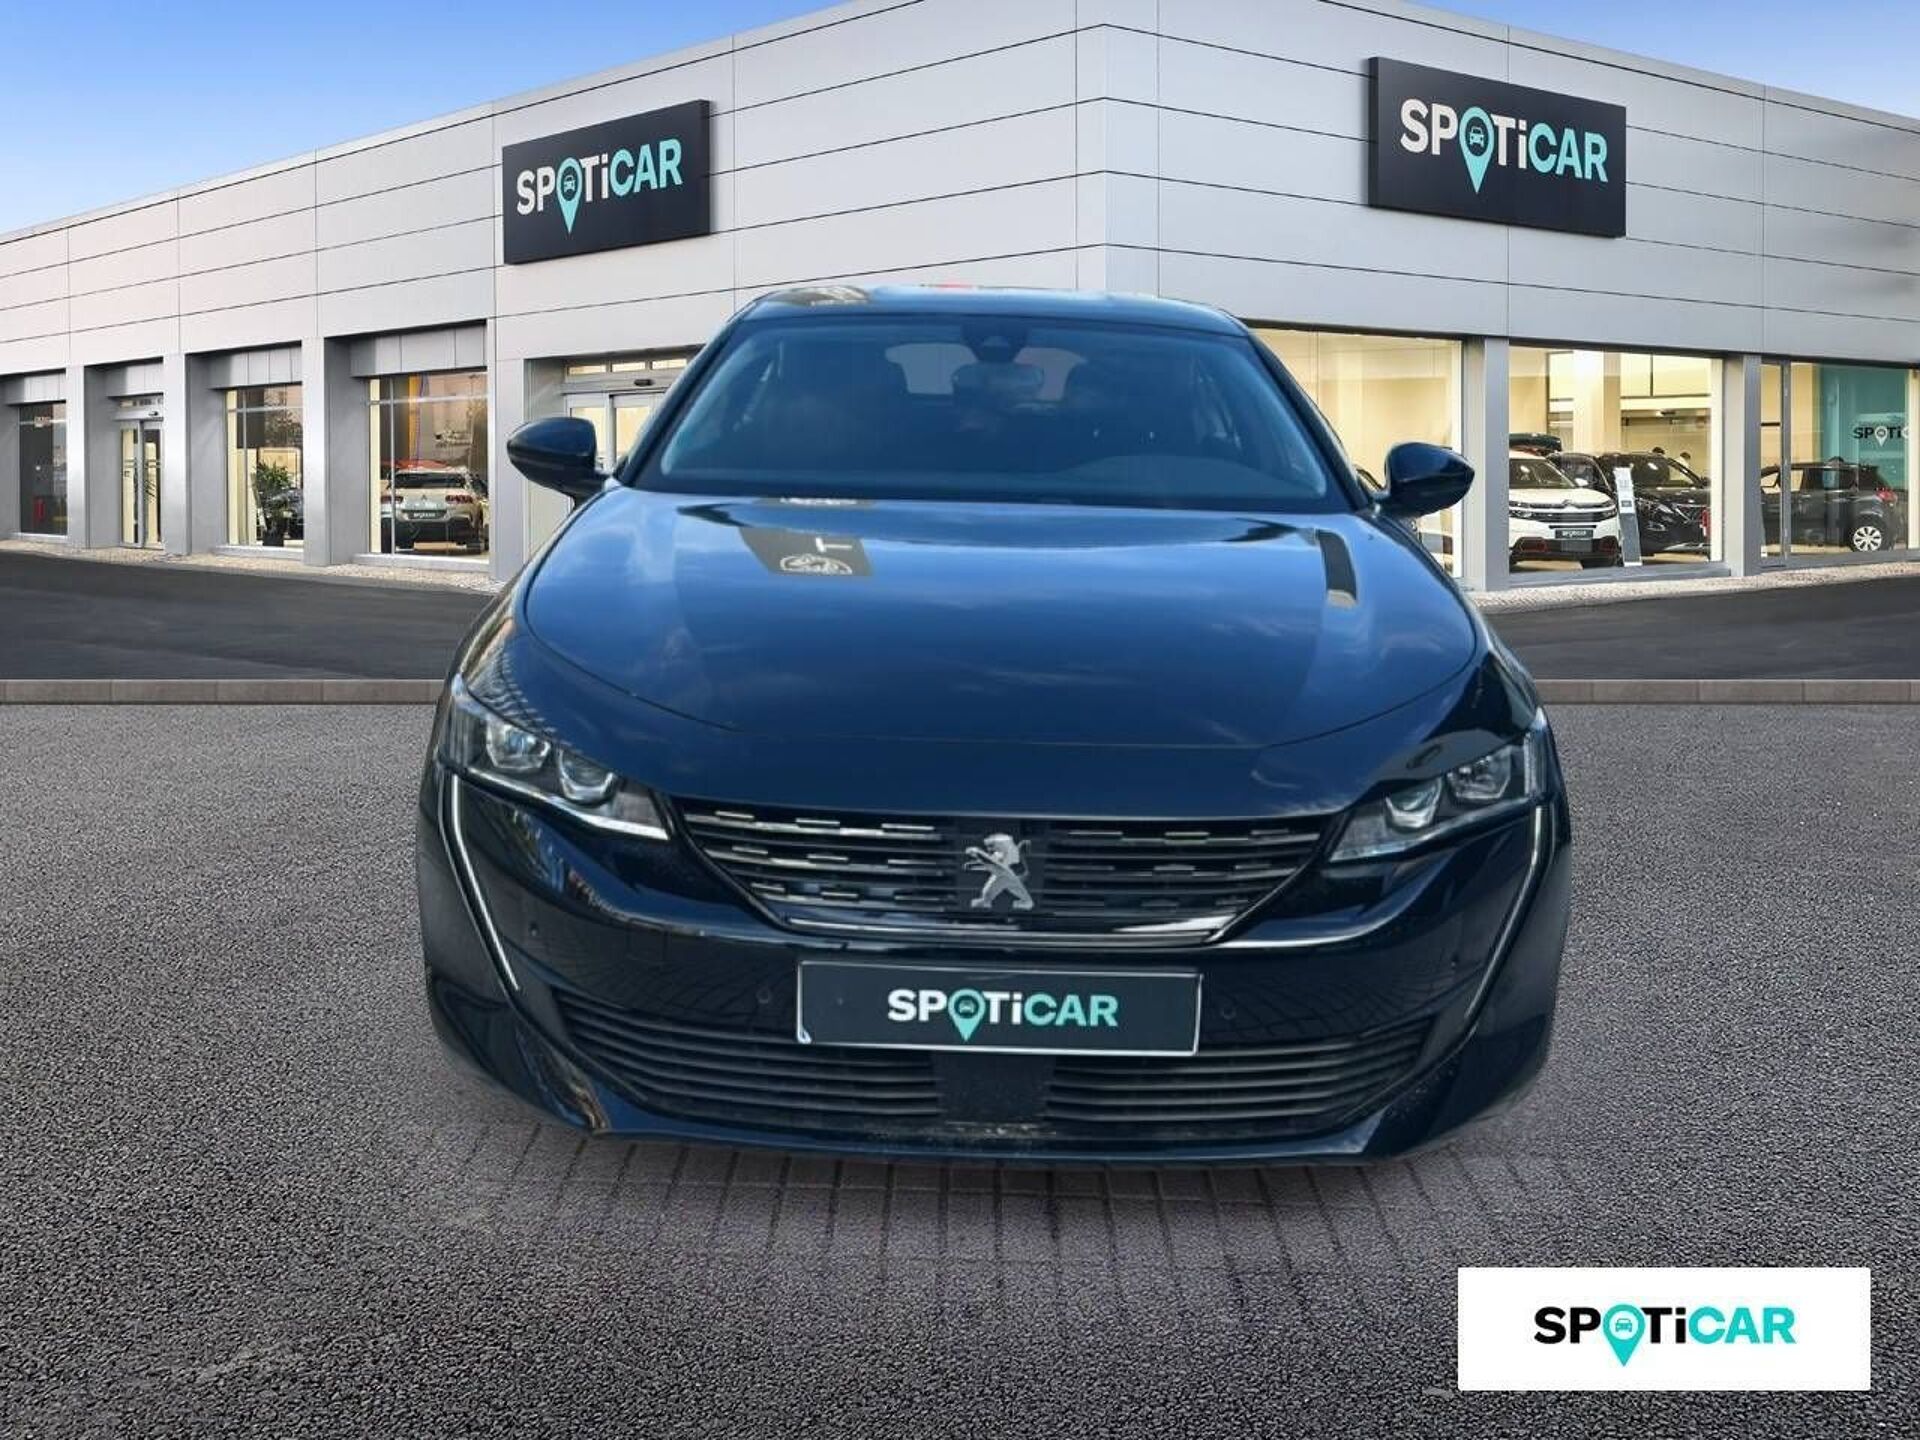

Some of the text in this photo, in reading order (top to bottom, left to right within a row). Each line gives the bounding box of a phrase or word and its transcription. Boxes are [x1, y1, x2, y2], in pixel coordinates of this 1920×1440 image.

[517, 138, 683, 234] SPOTiCAR
[1400, 98, 1608, 194] SPOTiCAR
[887, 988, 1119, 1042] SPOTiCAR
